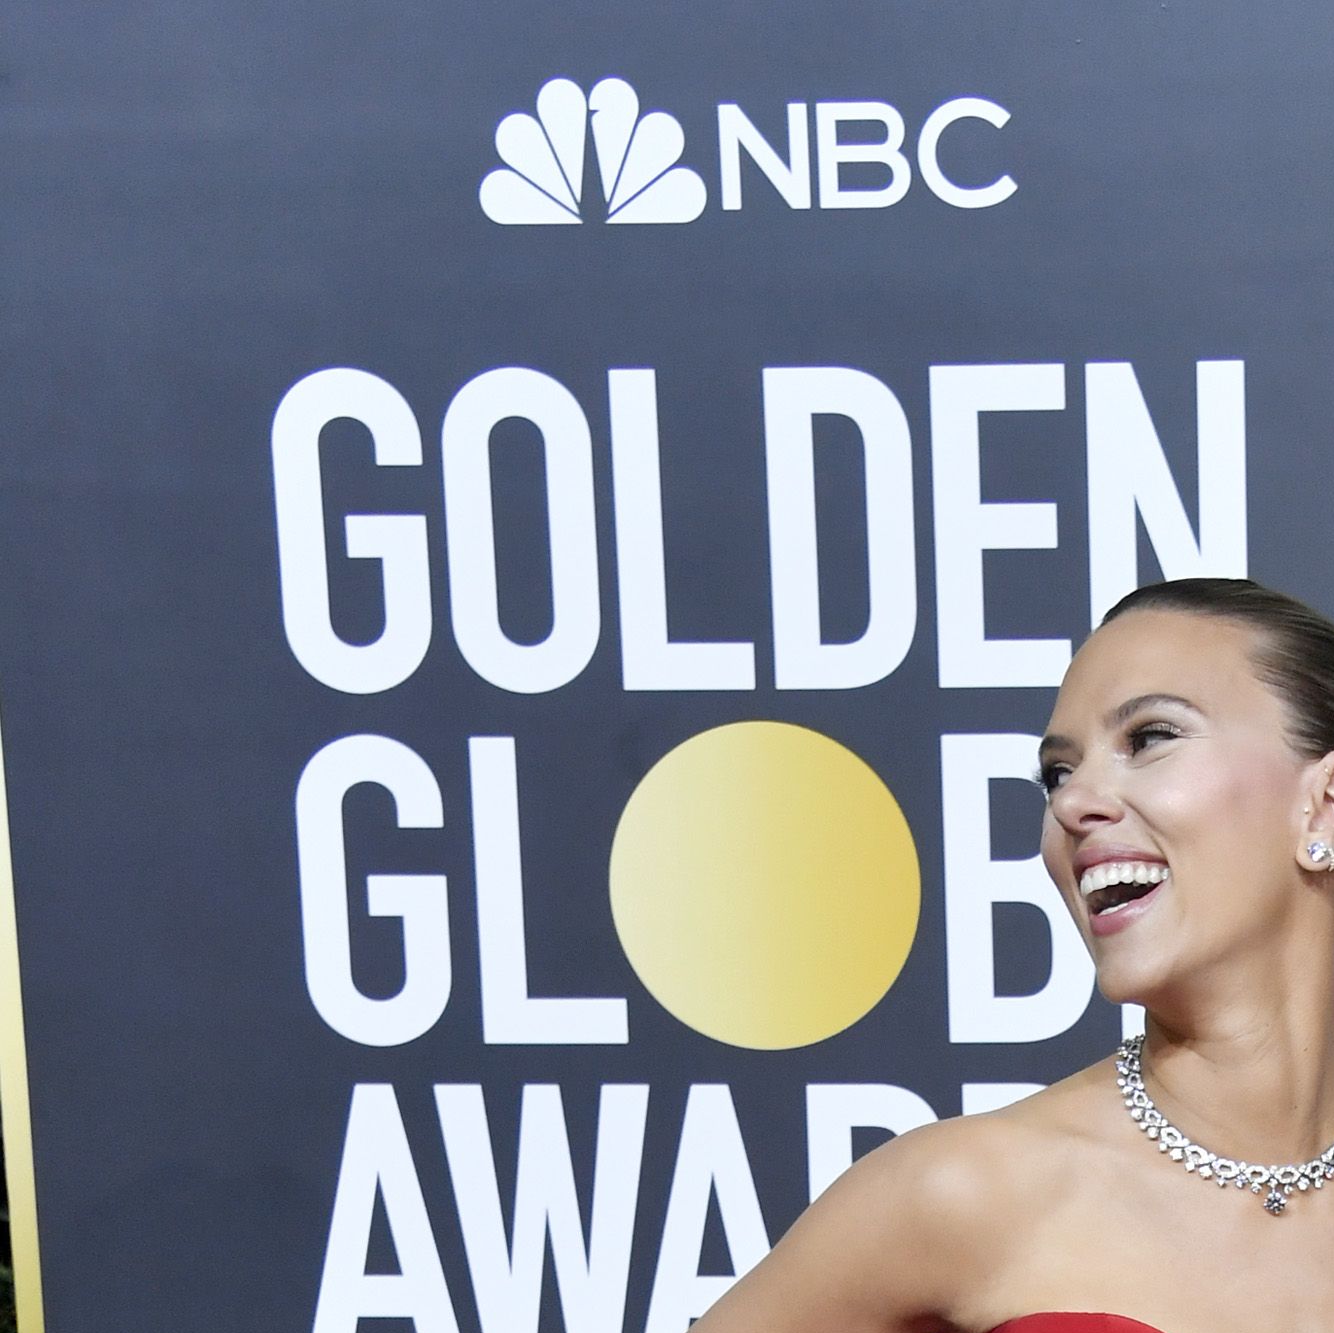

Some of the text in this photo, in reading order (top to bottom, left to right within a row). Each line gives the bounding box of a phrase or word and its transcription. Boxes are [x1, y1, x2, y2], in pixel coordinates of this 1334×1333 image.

[717, 97, 1018, 210] NBC
[271, 360, 1249, 694] GOLDEN
[294, 720, 1145, 1051] GLOB
